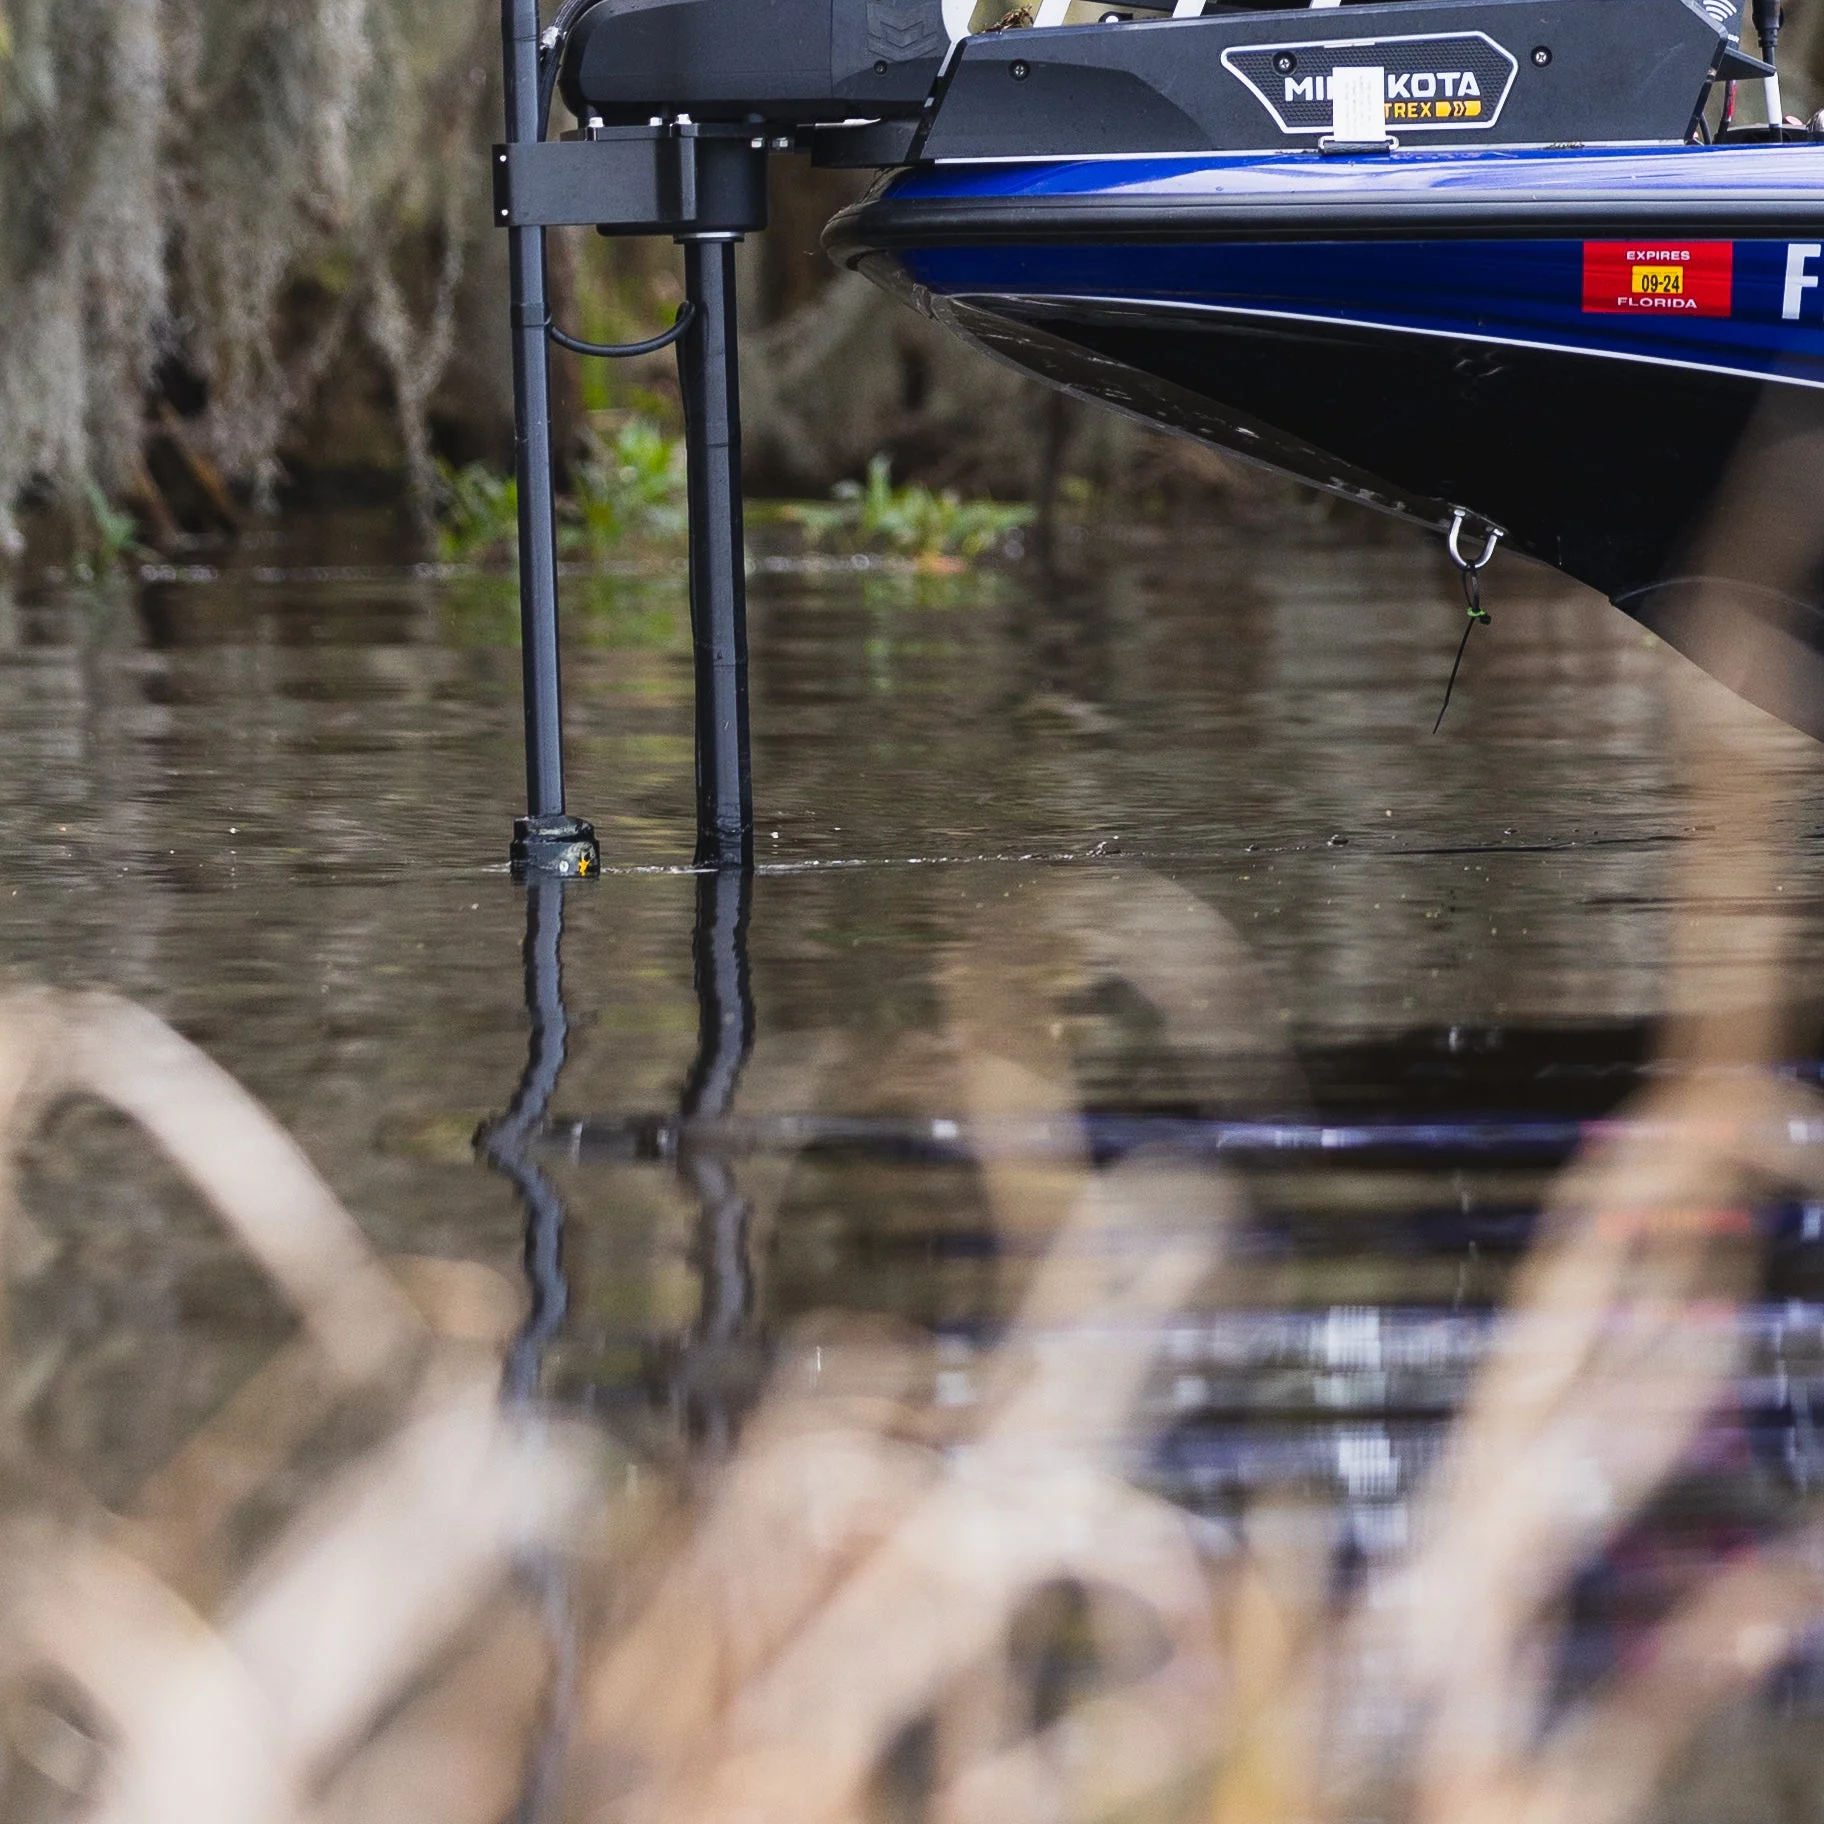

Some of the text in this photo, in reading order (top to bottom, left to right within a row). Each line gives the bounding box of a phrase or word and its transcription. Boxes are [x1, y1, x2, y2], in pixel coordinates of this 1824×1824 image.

[1387, 71, 1481, 99] KOTA
[1626, 250, 1691, 261] EXPIRES
[1641, 274, 1680, 293] 09-24
[1617, 296, 1698, 309] FLORIDA
